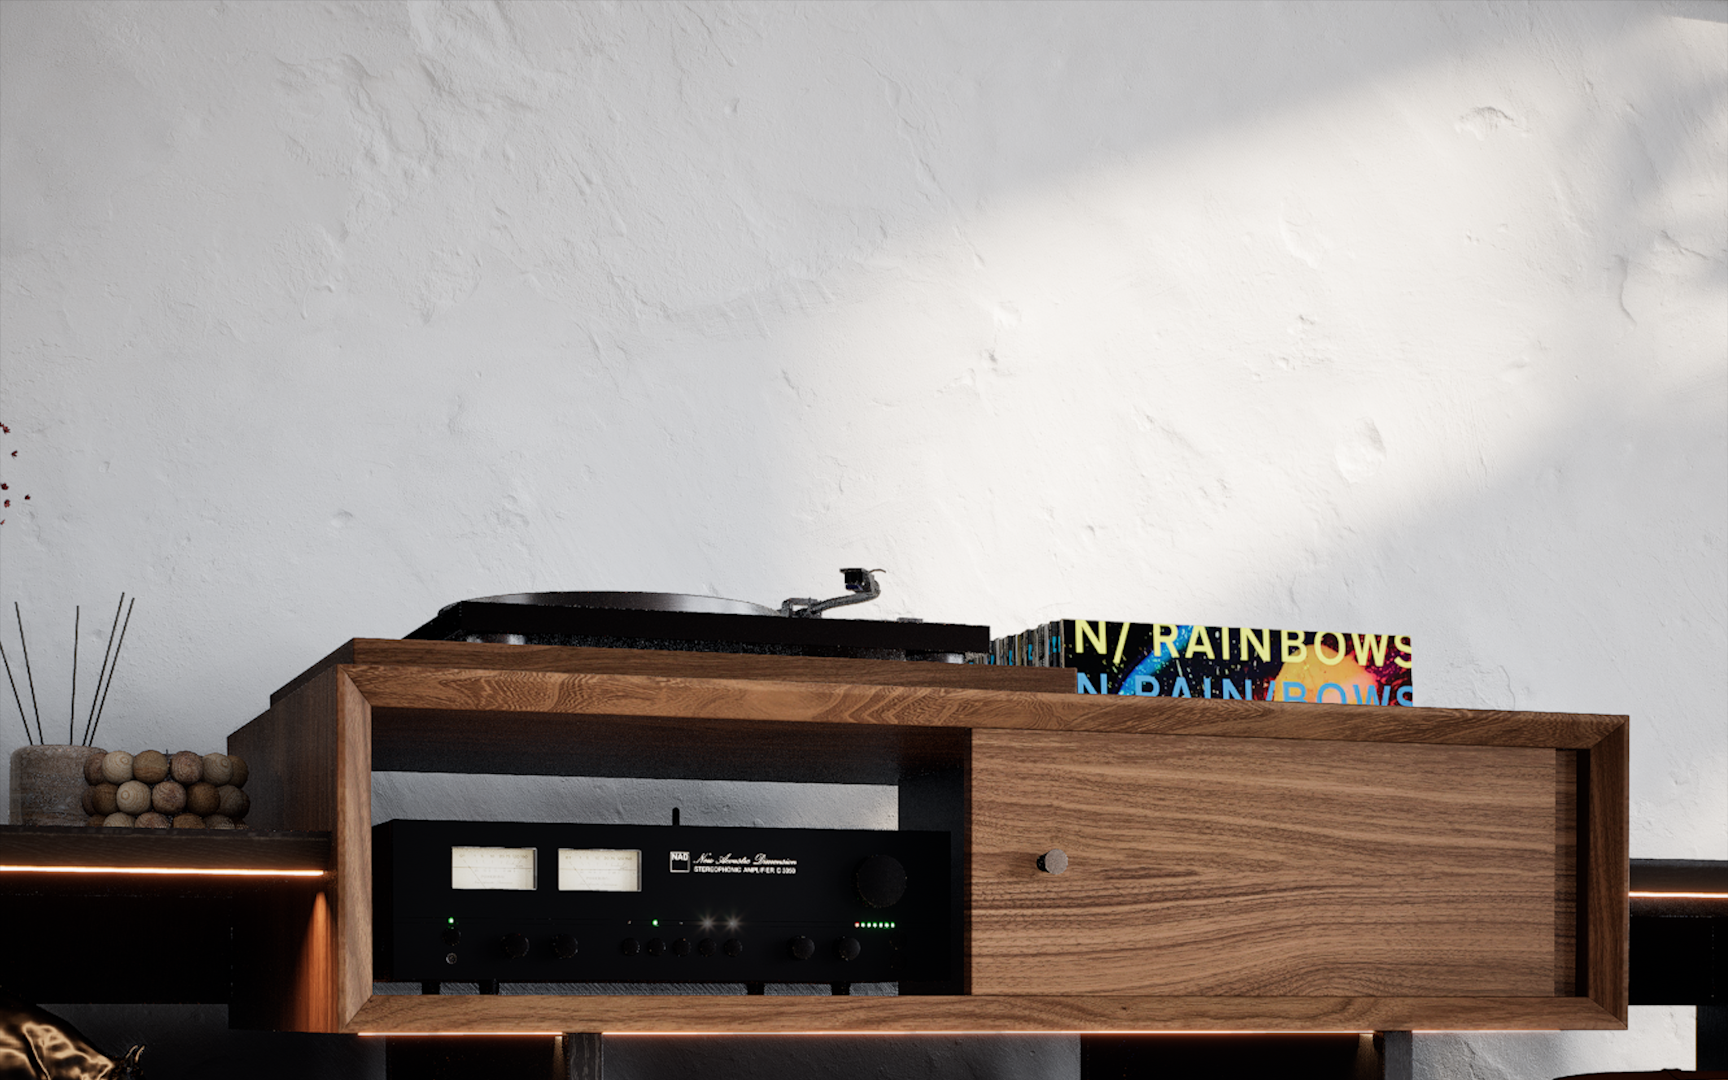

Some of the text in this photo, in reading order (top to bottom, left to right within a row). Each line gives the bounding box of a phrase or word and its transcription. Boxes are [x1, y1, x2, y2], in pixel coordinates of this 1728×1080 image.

[1153, 624, 1412, 669] RAINBOWS
[671, 852, 689, 861] NAD
[752, 853, 797, 865] Dimension
[693, 865, 741, 873] STEREOPHONIC
[743, 866, 775, 874] AMPLIFIER
